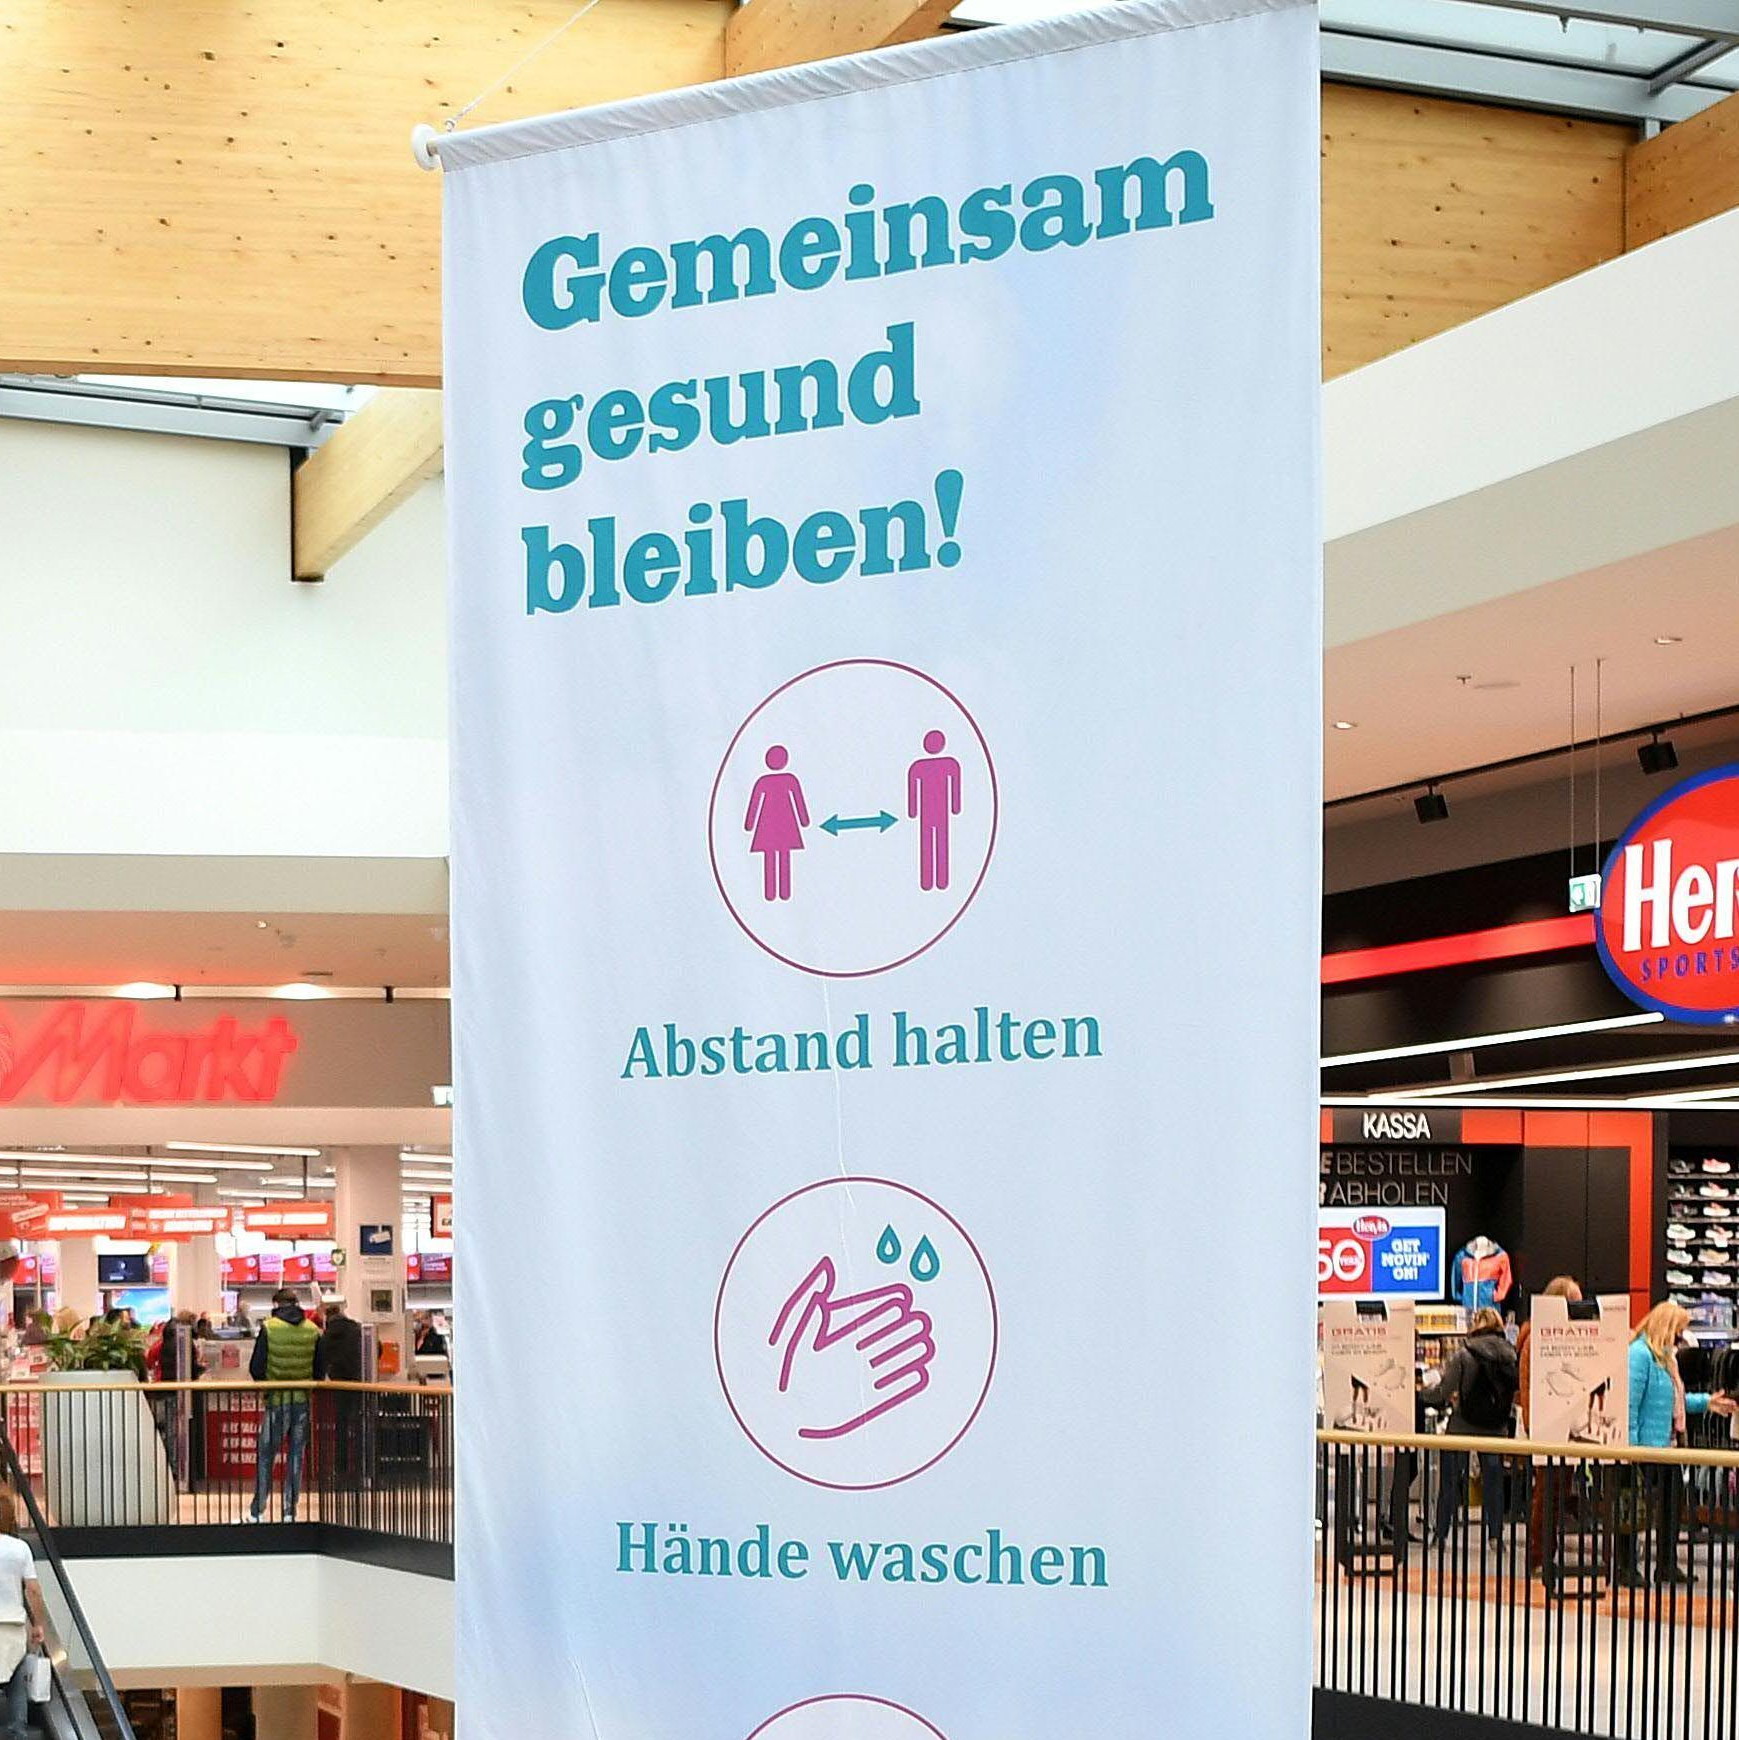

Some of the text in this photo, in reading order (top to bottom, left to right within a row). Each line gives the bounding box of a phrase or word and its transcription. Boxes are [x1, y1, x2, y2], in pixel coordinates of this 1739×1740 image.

[522, 149, 1214, 331] Gemeinsam
[521, 321, 920, 490] gesund
[521, 468, 963, 615] bleiben!
[1623, 838, 1739, 952] Her
[620, 1005, 1102, 1079] Abstand halten
[1337, 1151, 1472, 1175] BESTELLEN
[1363, 1112, 1431, 1140] KASSA
[1329, 1181, 1448, 1206] ABHOLEN
[615, 1520, 1109, 1587] Hände waschen
